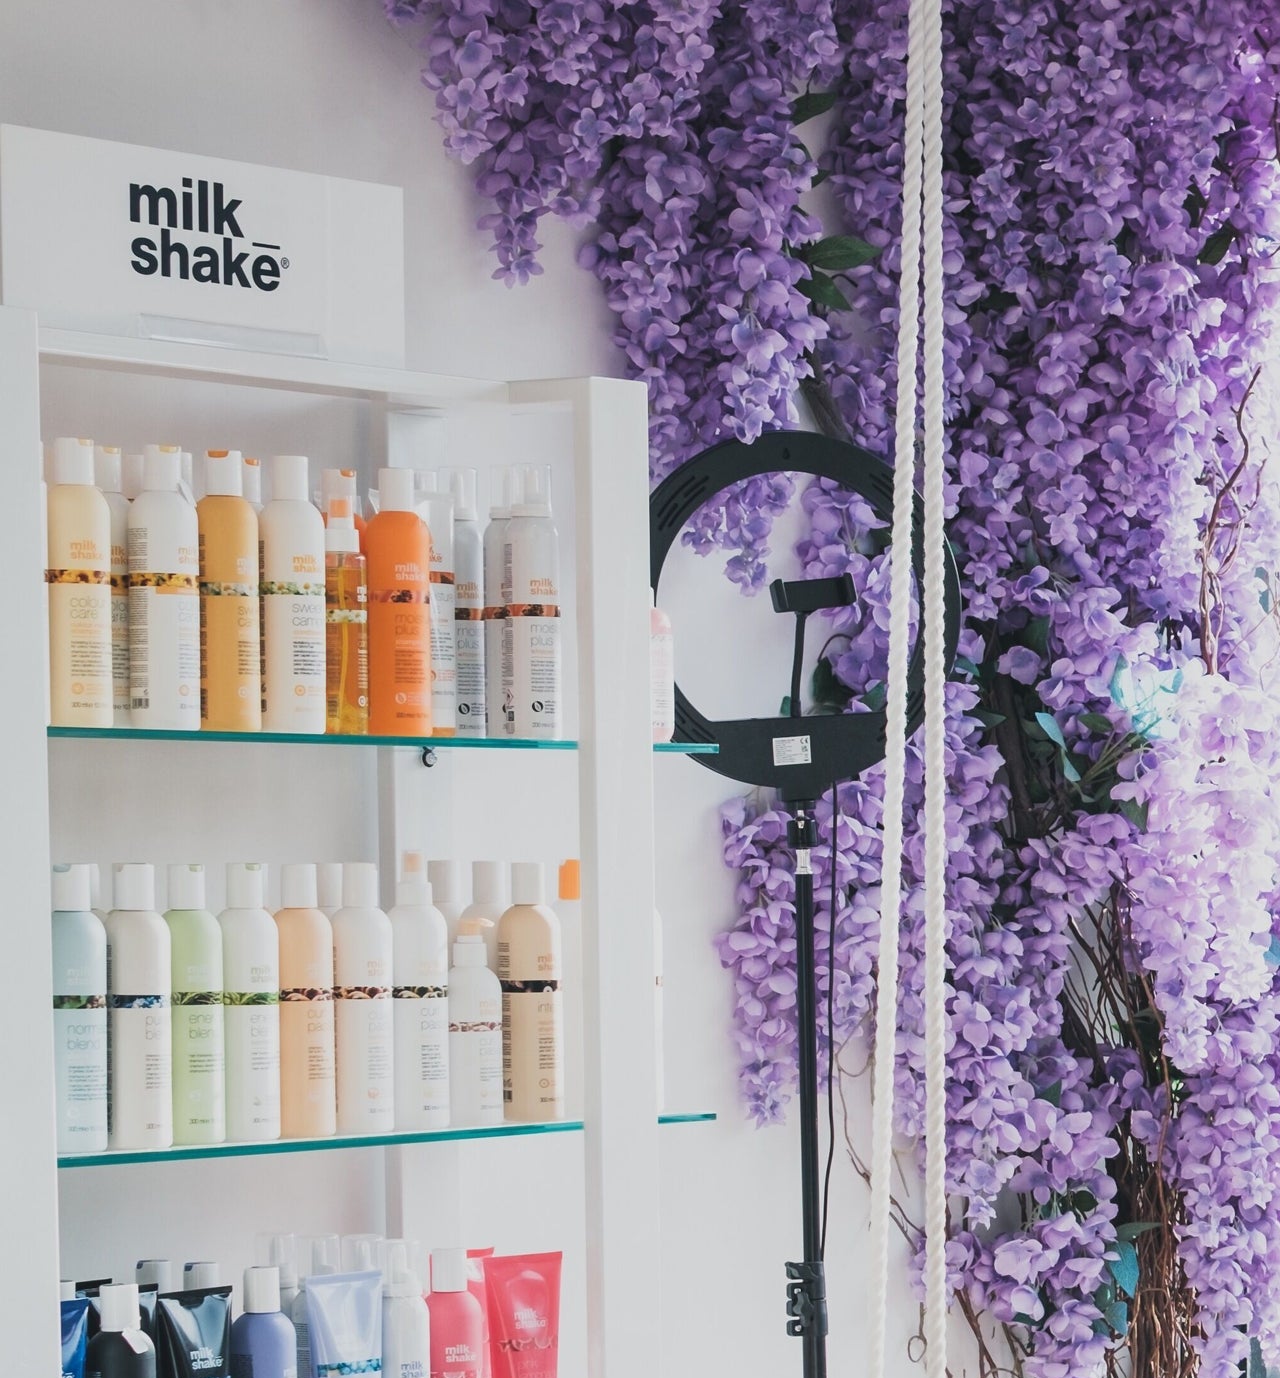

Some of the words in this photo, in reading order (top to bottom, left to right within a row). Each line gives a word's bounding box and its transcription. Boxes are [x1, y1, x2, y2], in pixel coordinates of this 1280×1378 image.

[129, 177, 245, 239] milk
[395, 563, 420, 572] milk
[530, 578, 553, 587] milk
[530, 634, 554, 647] plus
[514, 1308, 539, 1320] milk
[190, 1347, 214, 1360] milk
[445, 1344, 470, 1355] milk
[445, 1353, 477, 1363] shake
[401, 1361, 424, 1371] milk
